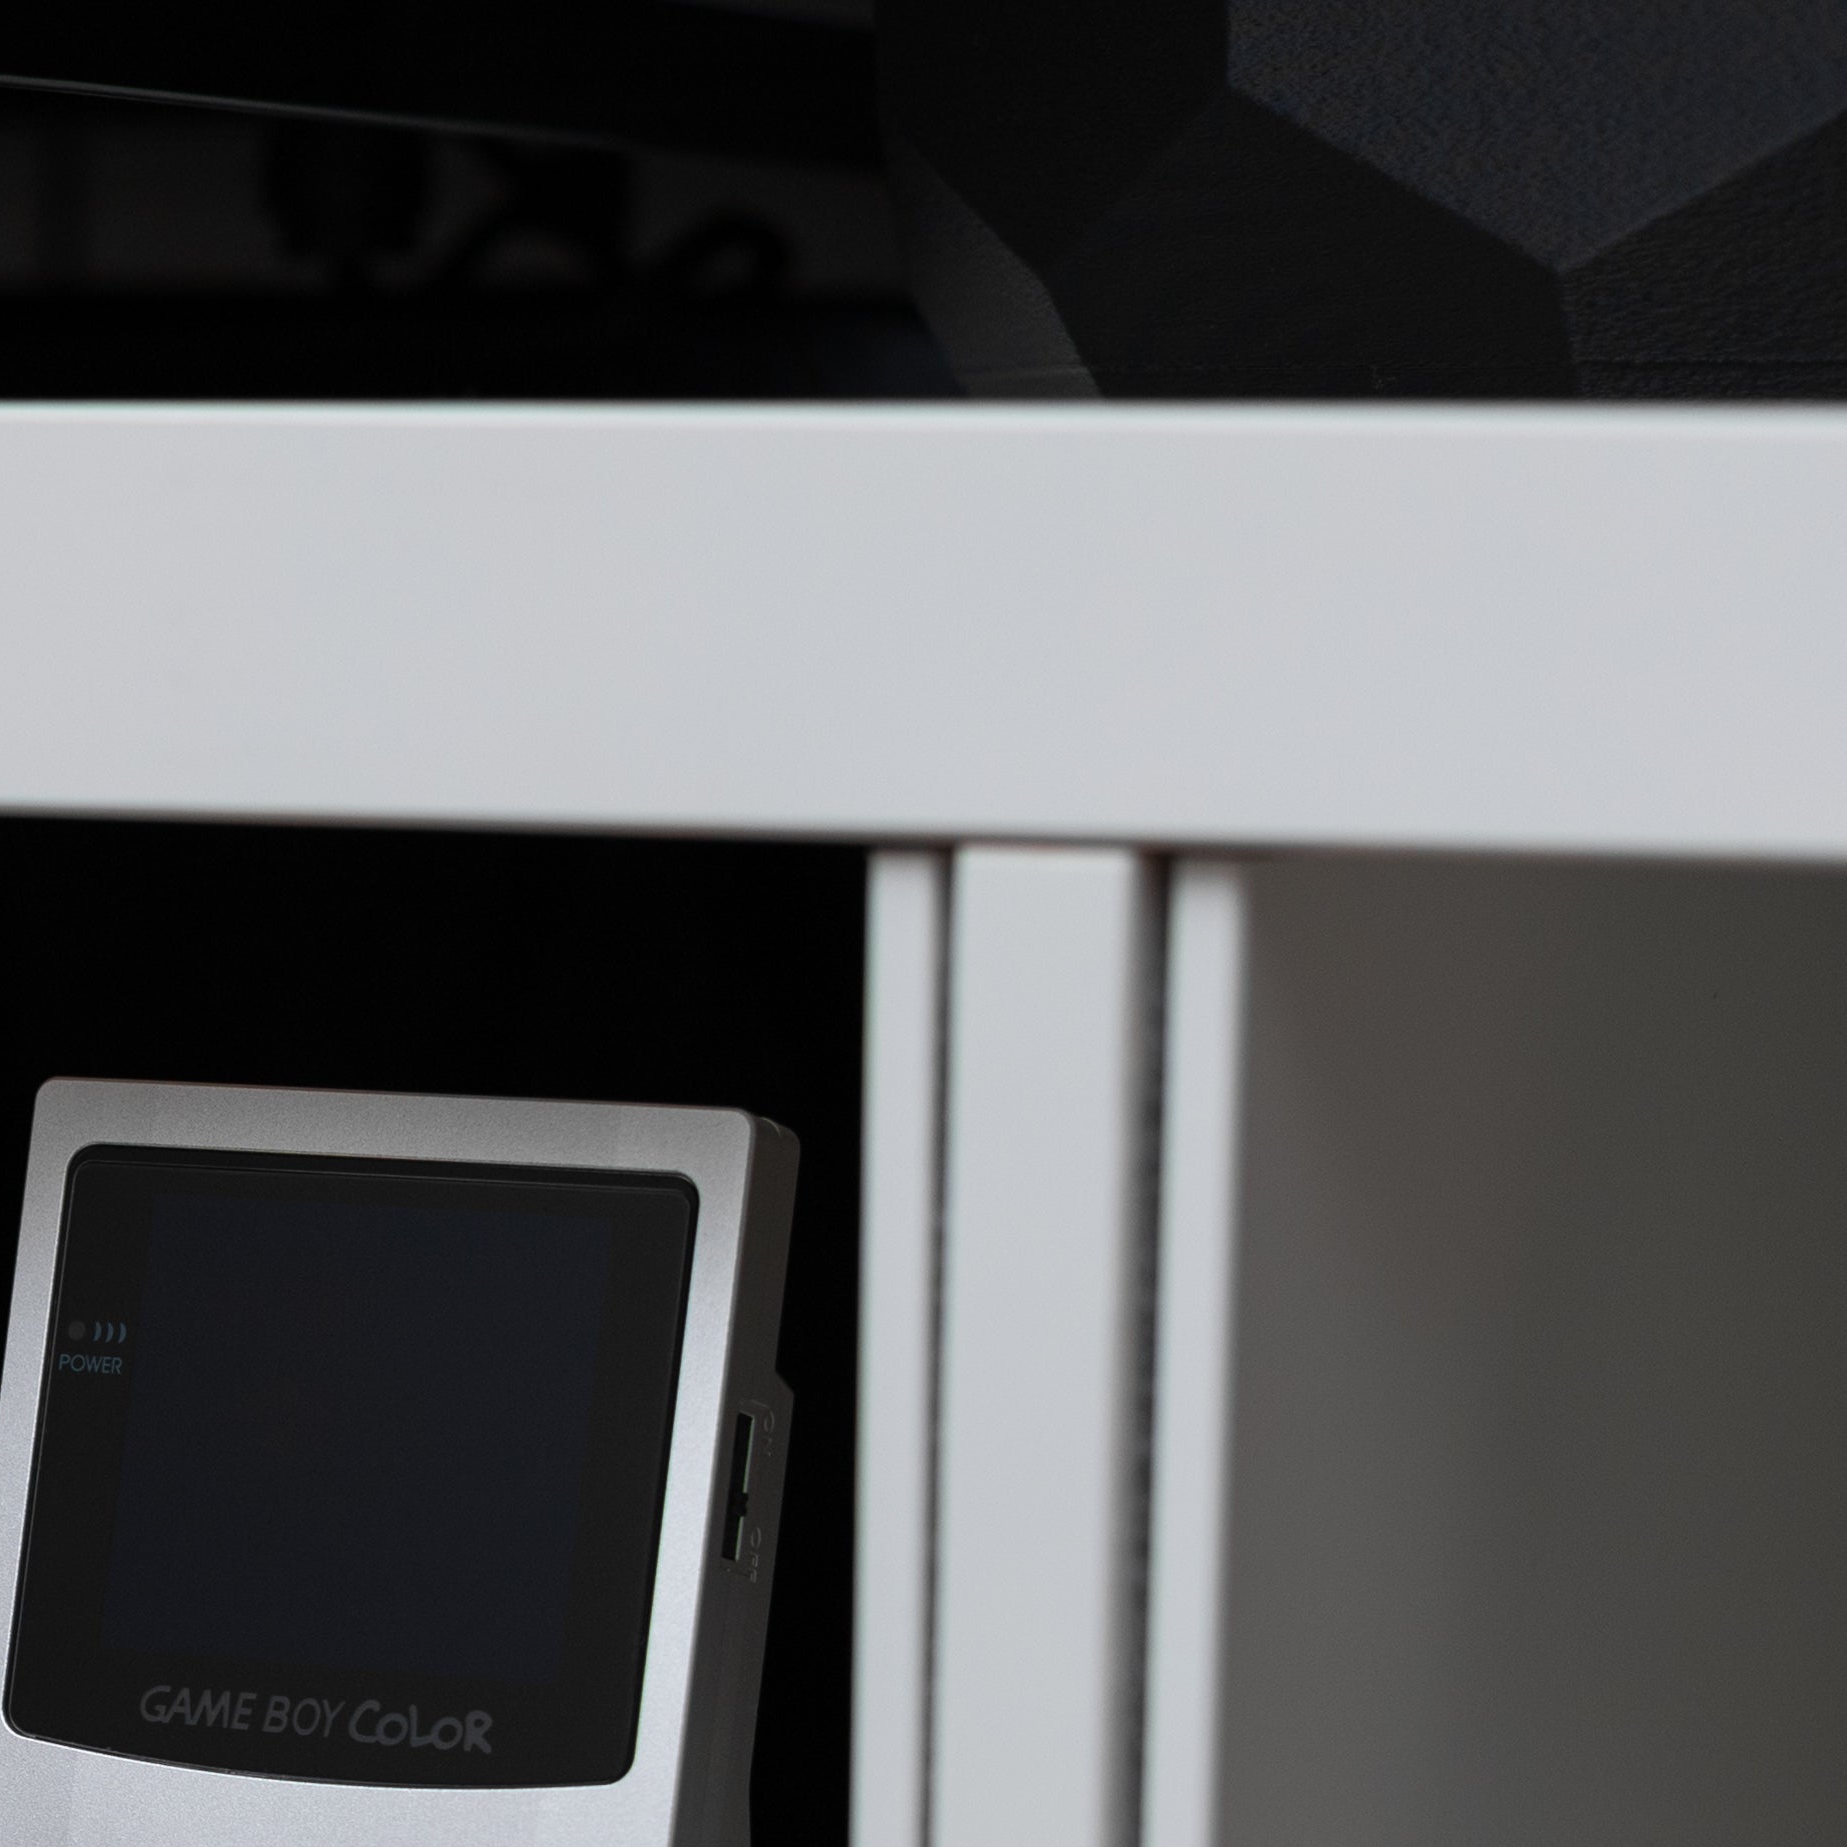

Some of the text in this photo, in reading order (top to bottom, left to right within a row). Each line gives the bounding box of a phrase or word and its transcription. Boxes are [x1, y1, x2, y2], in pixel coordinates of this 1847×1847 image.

[58, 1353, 123, 1375] POWER
[139, 1684, 257, 1731] GAME
[262, 1694, 346, 1738] BOY
